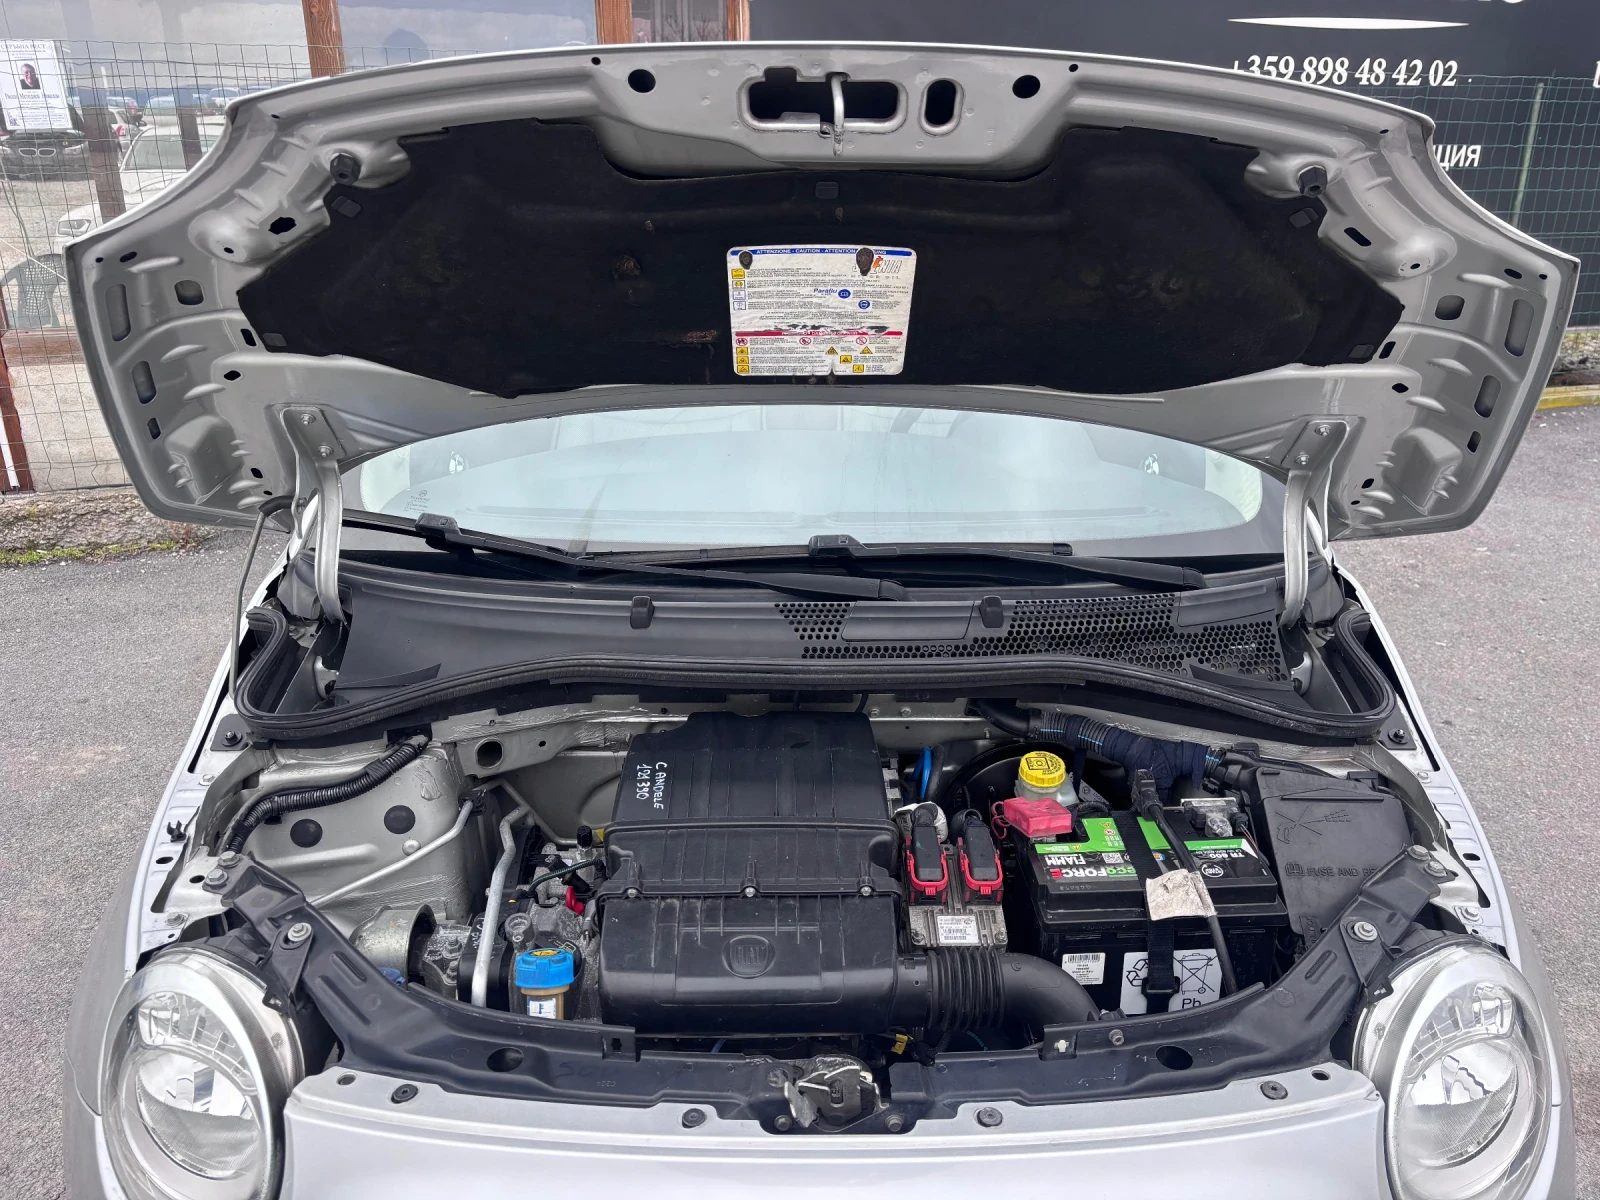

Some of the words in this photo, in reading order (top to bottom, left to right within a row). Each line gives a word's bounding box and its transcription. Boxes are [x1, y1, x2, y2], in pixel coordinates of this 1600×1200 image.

[1301, 56, 1349, 85] 898
[1354, 57, 1387, 86] 48
[1391, 58, 1423, 86] 42
[1428, 59, 1458, 87] 02
[1433, 144, 1481, 171] ЦИЯ
[1044, 853, 1087, 866] FIAMM
[1307, 867, 1335, 877] FUSE
[1338, 867, 1359, 877] AND
[1181, 997, 1202, 1009] Pb
